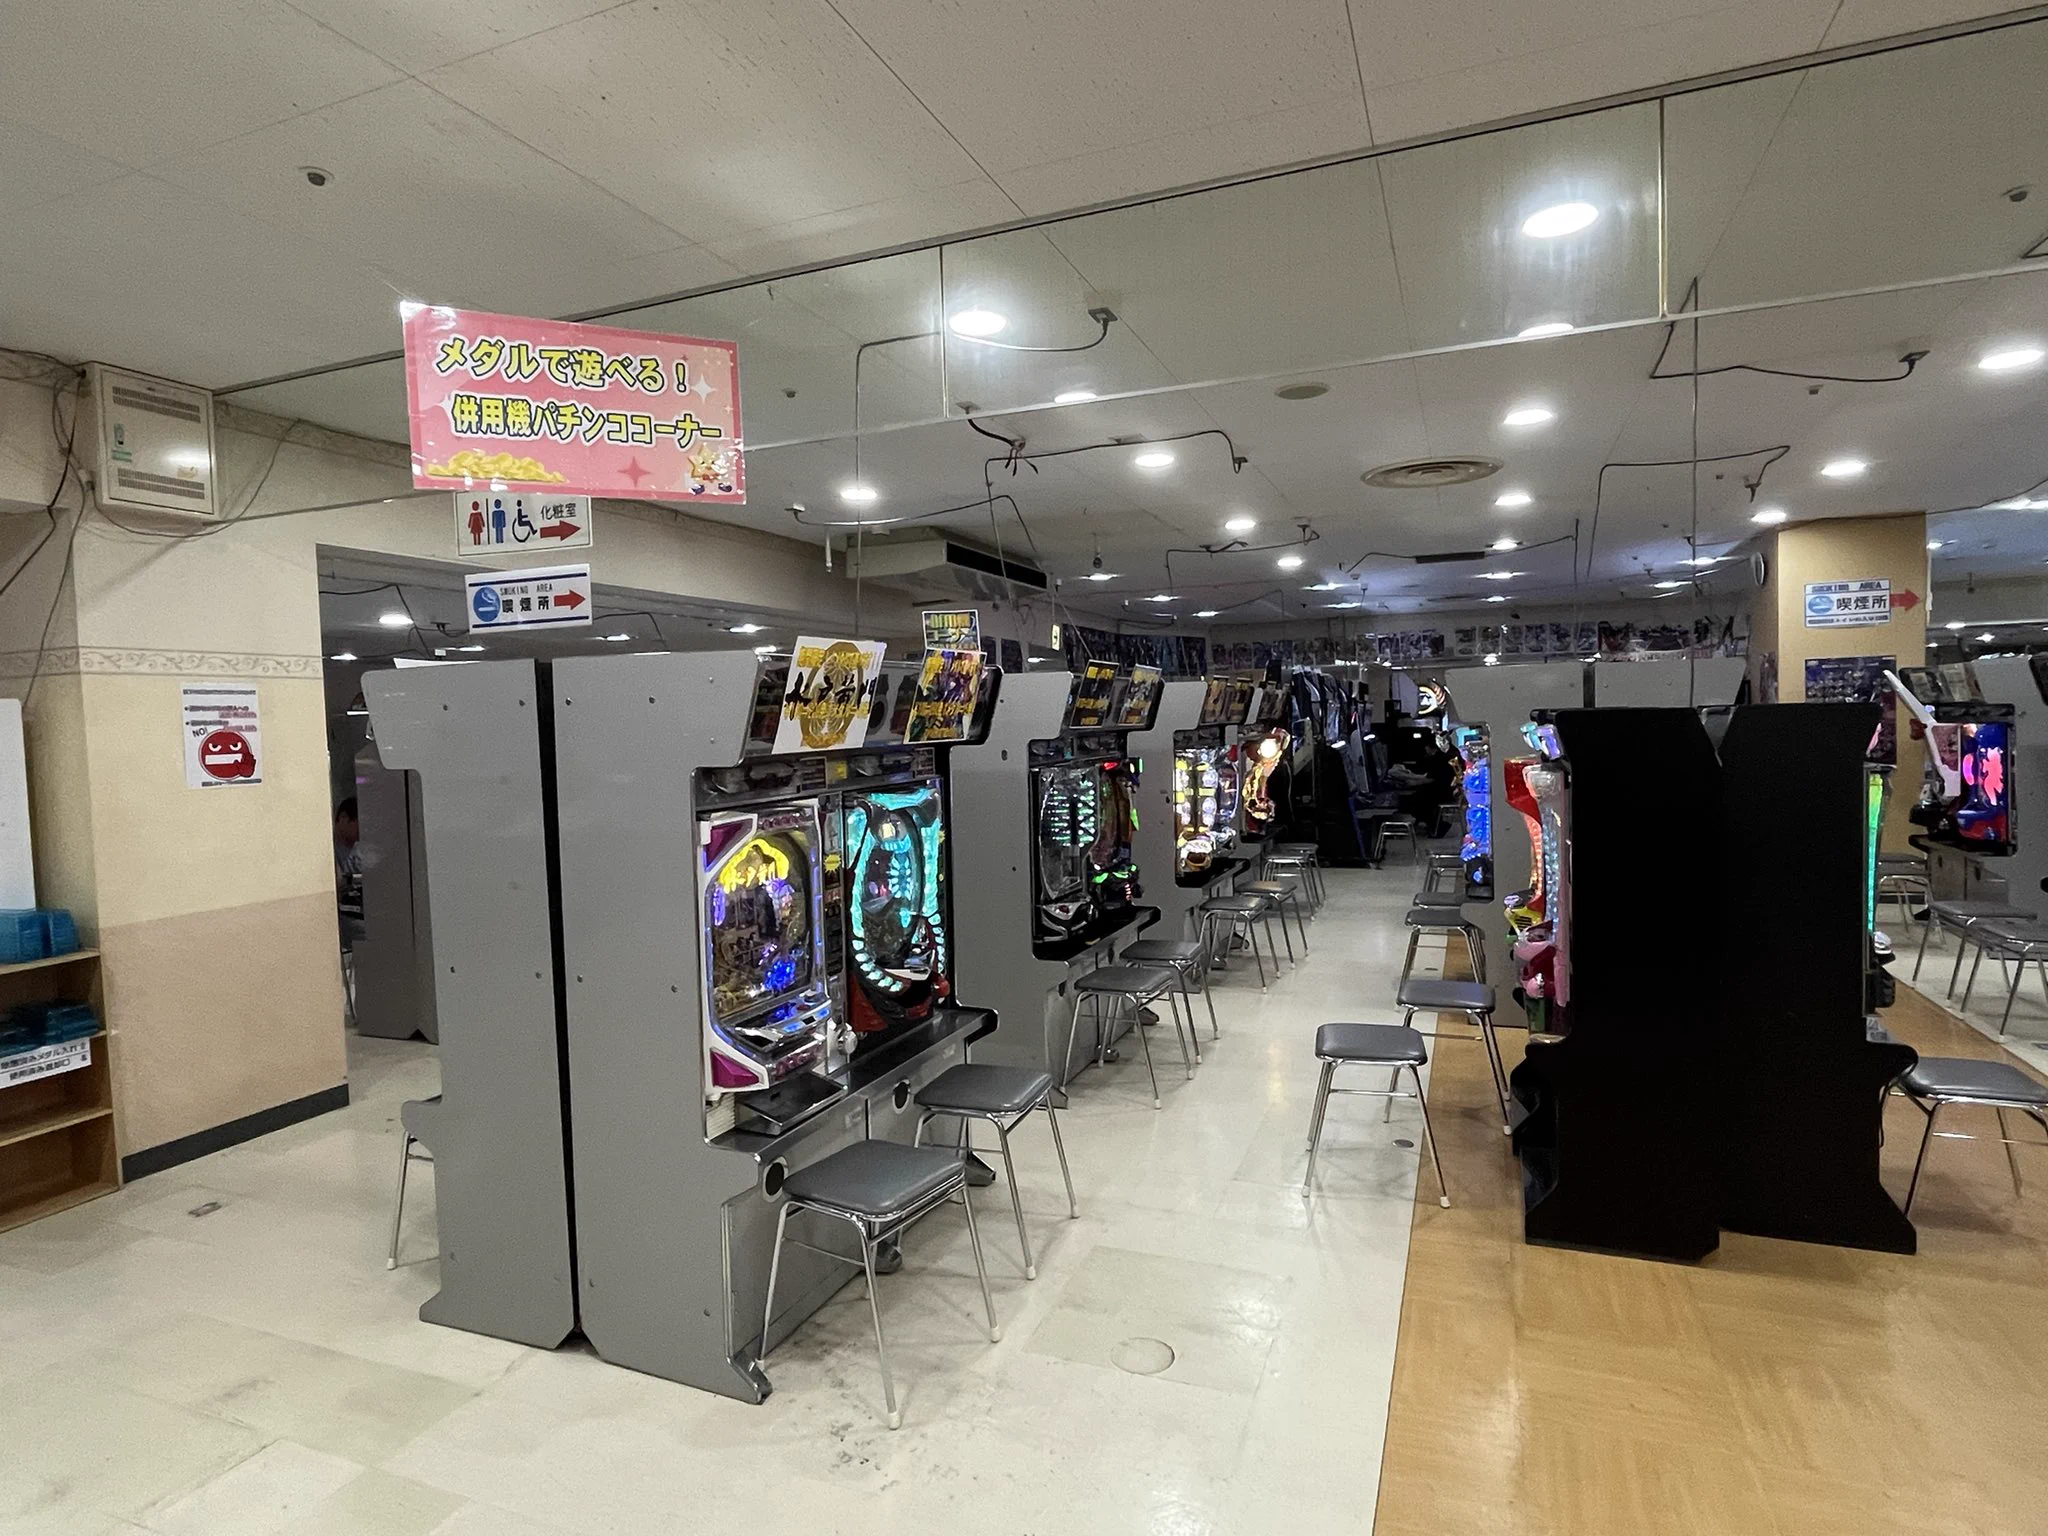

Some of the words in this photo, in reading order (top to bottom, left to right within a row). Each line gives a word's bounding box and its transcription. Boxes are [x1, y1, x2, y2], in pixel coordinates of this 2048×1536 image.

[437, 338, 688, 393] メダルで遊べる！
[451, 394, 722, 448] 併用機パチンココーナー
[541, 503, 576, 520] 化粧室
[536, 583, 553, 593] AREA
[501, 596, 549, 613] 喫煙所
[1836, 594, 1887, 611] 喫煙所
